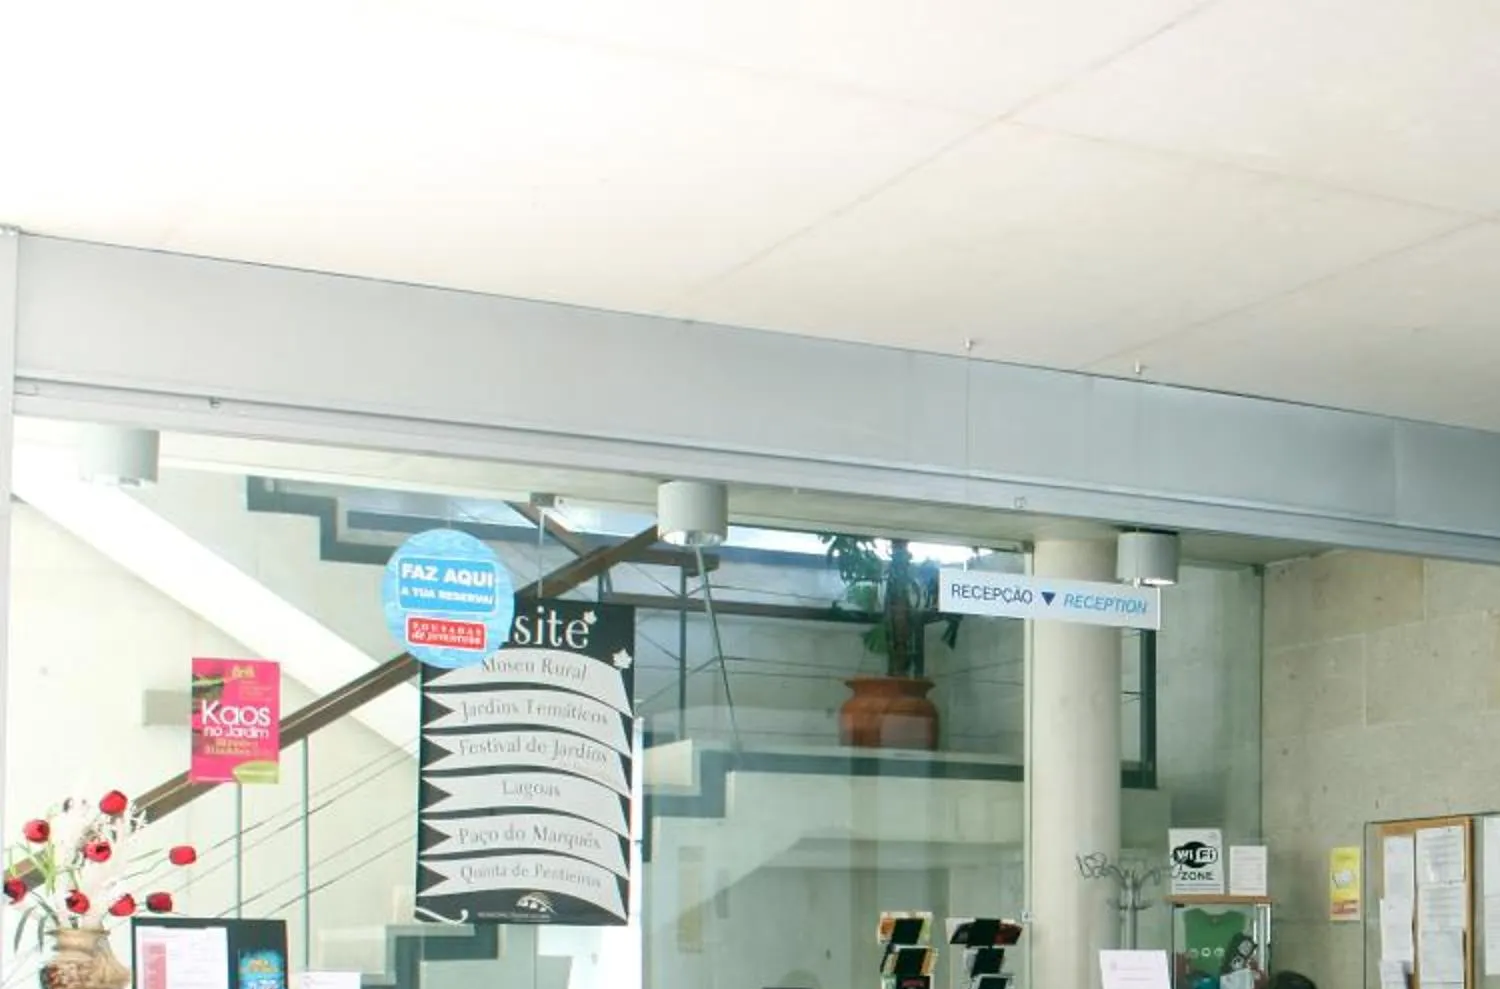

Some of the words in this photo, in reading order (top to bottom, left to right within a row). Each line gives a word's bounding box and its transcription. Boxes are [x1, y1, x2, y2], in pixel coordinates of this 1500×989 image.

[401, 563, 439, 581] FAZ
[443, 567, 494, 588] AQUI
[1063, 592, 1148, 615] RECEPTION
[513, 605, 590, 649] site
[541, 657, 588, 682] Rural
[202, 699, 271, 727] Kaos
[461, 699, 519, 721] Jardins
[526, 698, 609, 725] Temáticos
[203, 725, 223, 737] no
[226, 724, 269, 739] Jardim
[458, 735, 521, 756] Festival
[525, 736, 548, 755] de
[552, 741, 608, 763] Jardins
[502, 779, 561, 799] Lagoas
[458, 826, 499, 847] Paço
[504, 823, 527, 842] do
[532, 824, 602, 850] Marquês
[460, 865, 508, 885] Quinta
[511, 863, 531, 878] de
[1180, 871, 1215, 881] ZONE
